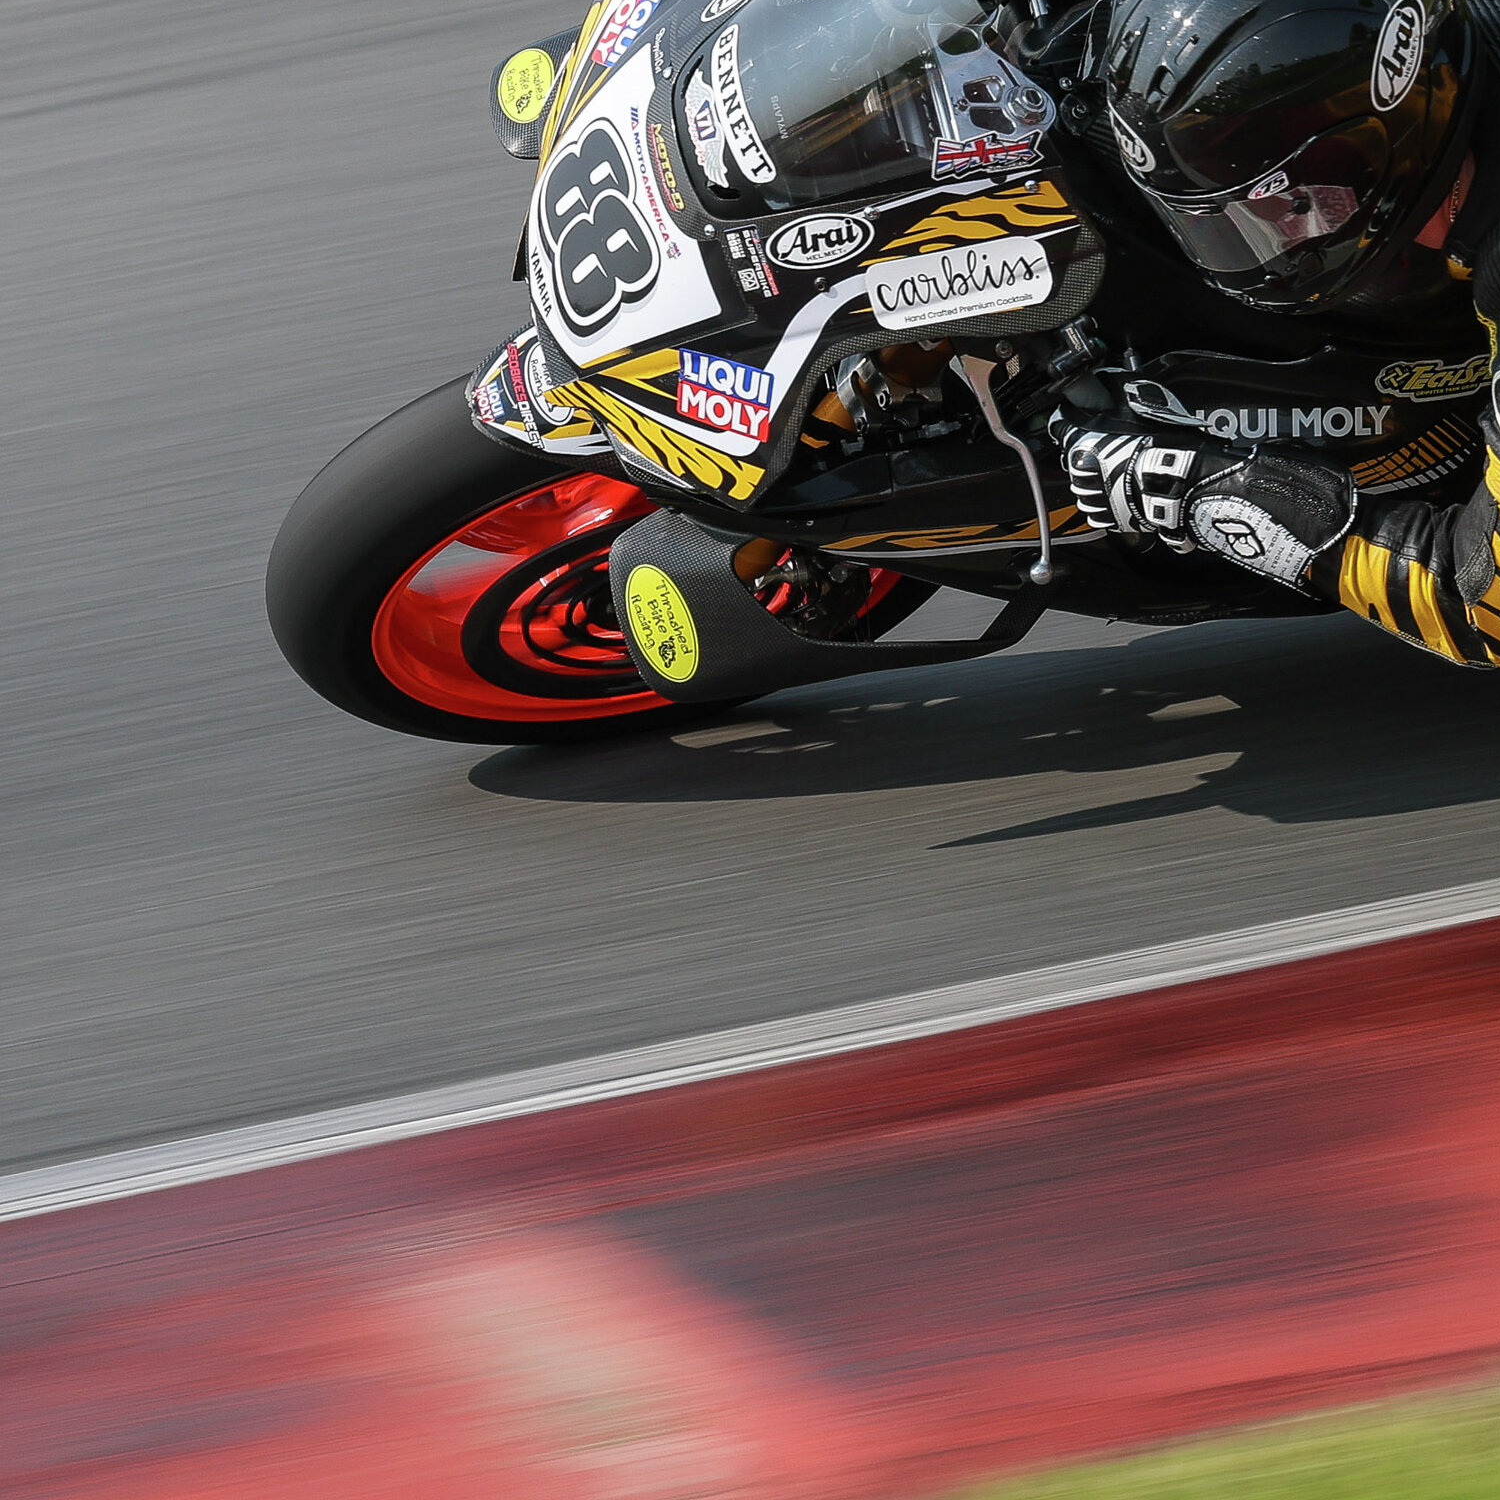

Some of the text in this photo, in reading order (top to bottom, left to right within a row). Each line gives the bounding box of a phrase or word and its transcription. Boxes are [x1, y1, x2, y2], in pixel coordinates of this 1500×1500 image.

[1380, 9, 1414, 101] Arai
[717, 28, 773, 177] BENNETT
[634, 131, 670, 243] MOTOAMERICA
[653, 123, 685, 211] MOTO-D
[543, 121, 660, 330] 88
[779, 218, 859, 260] Arai
[530, 246, 553, 318] YAMAHA
[742, 229, 773, 298] SUPERBIKE
[805, 249, 846, 262] HELMET
[904, 292, 1034, 324] Hand Crafted Premium Cocktails
[487, 381, 505, 419] LIQUI
[683, 351, 771, 404] LIQUI
[475, 387, 495, 423] MOLY
[681, 383, 769, 437] MOLY
[1195, 408, 1278, 440] IQUI
[1292, 405, 1391, 438] MOLY
[631, 594, 656, 651] Racing
[647, 599, 668, 634] Bike
[656, 579, 693, 655] Thrashed
